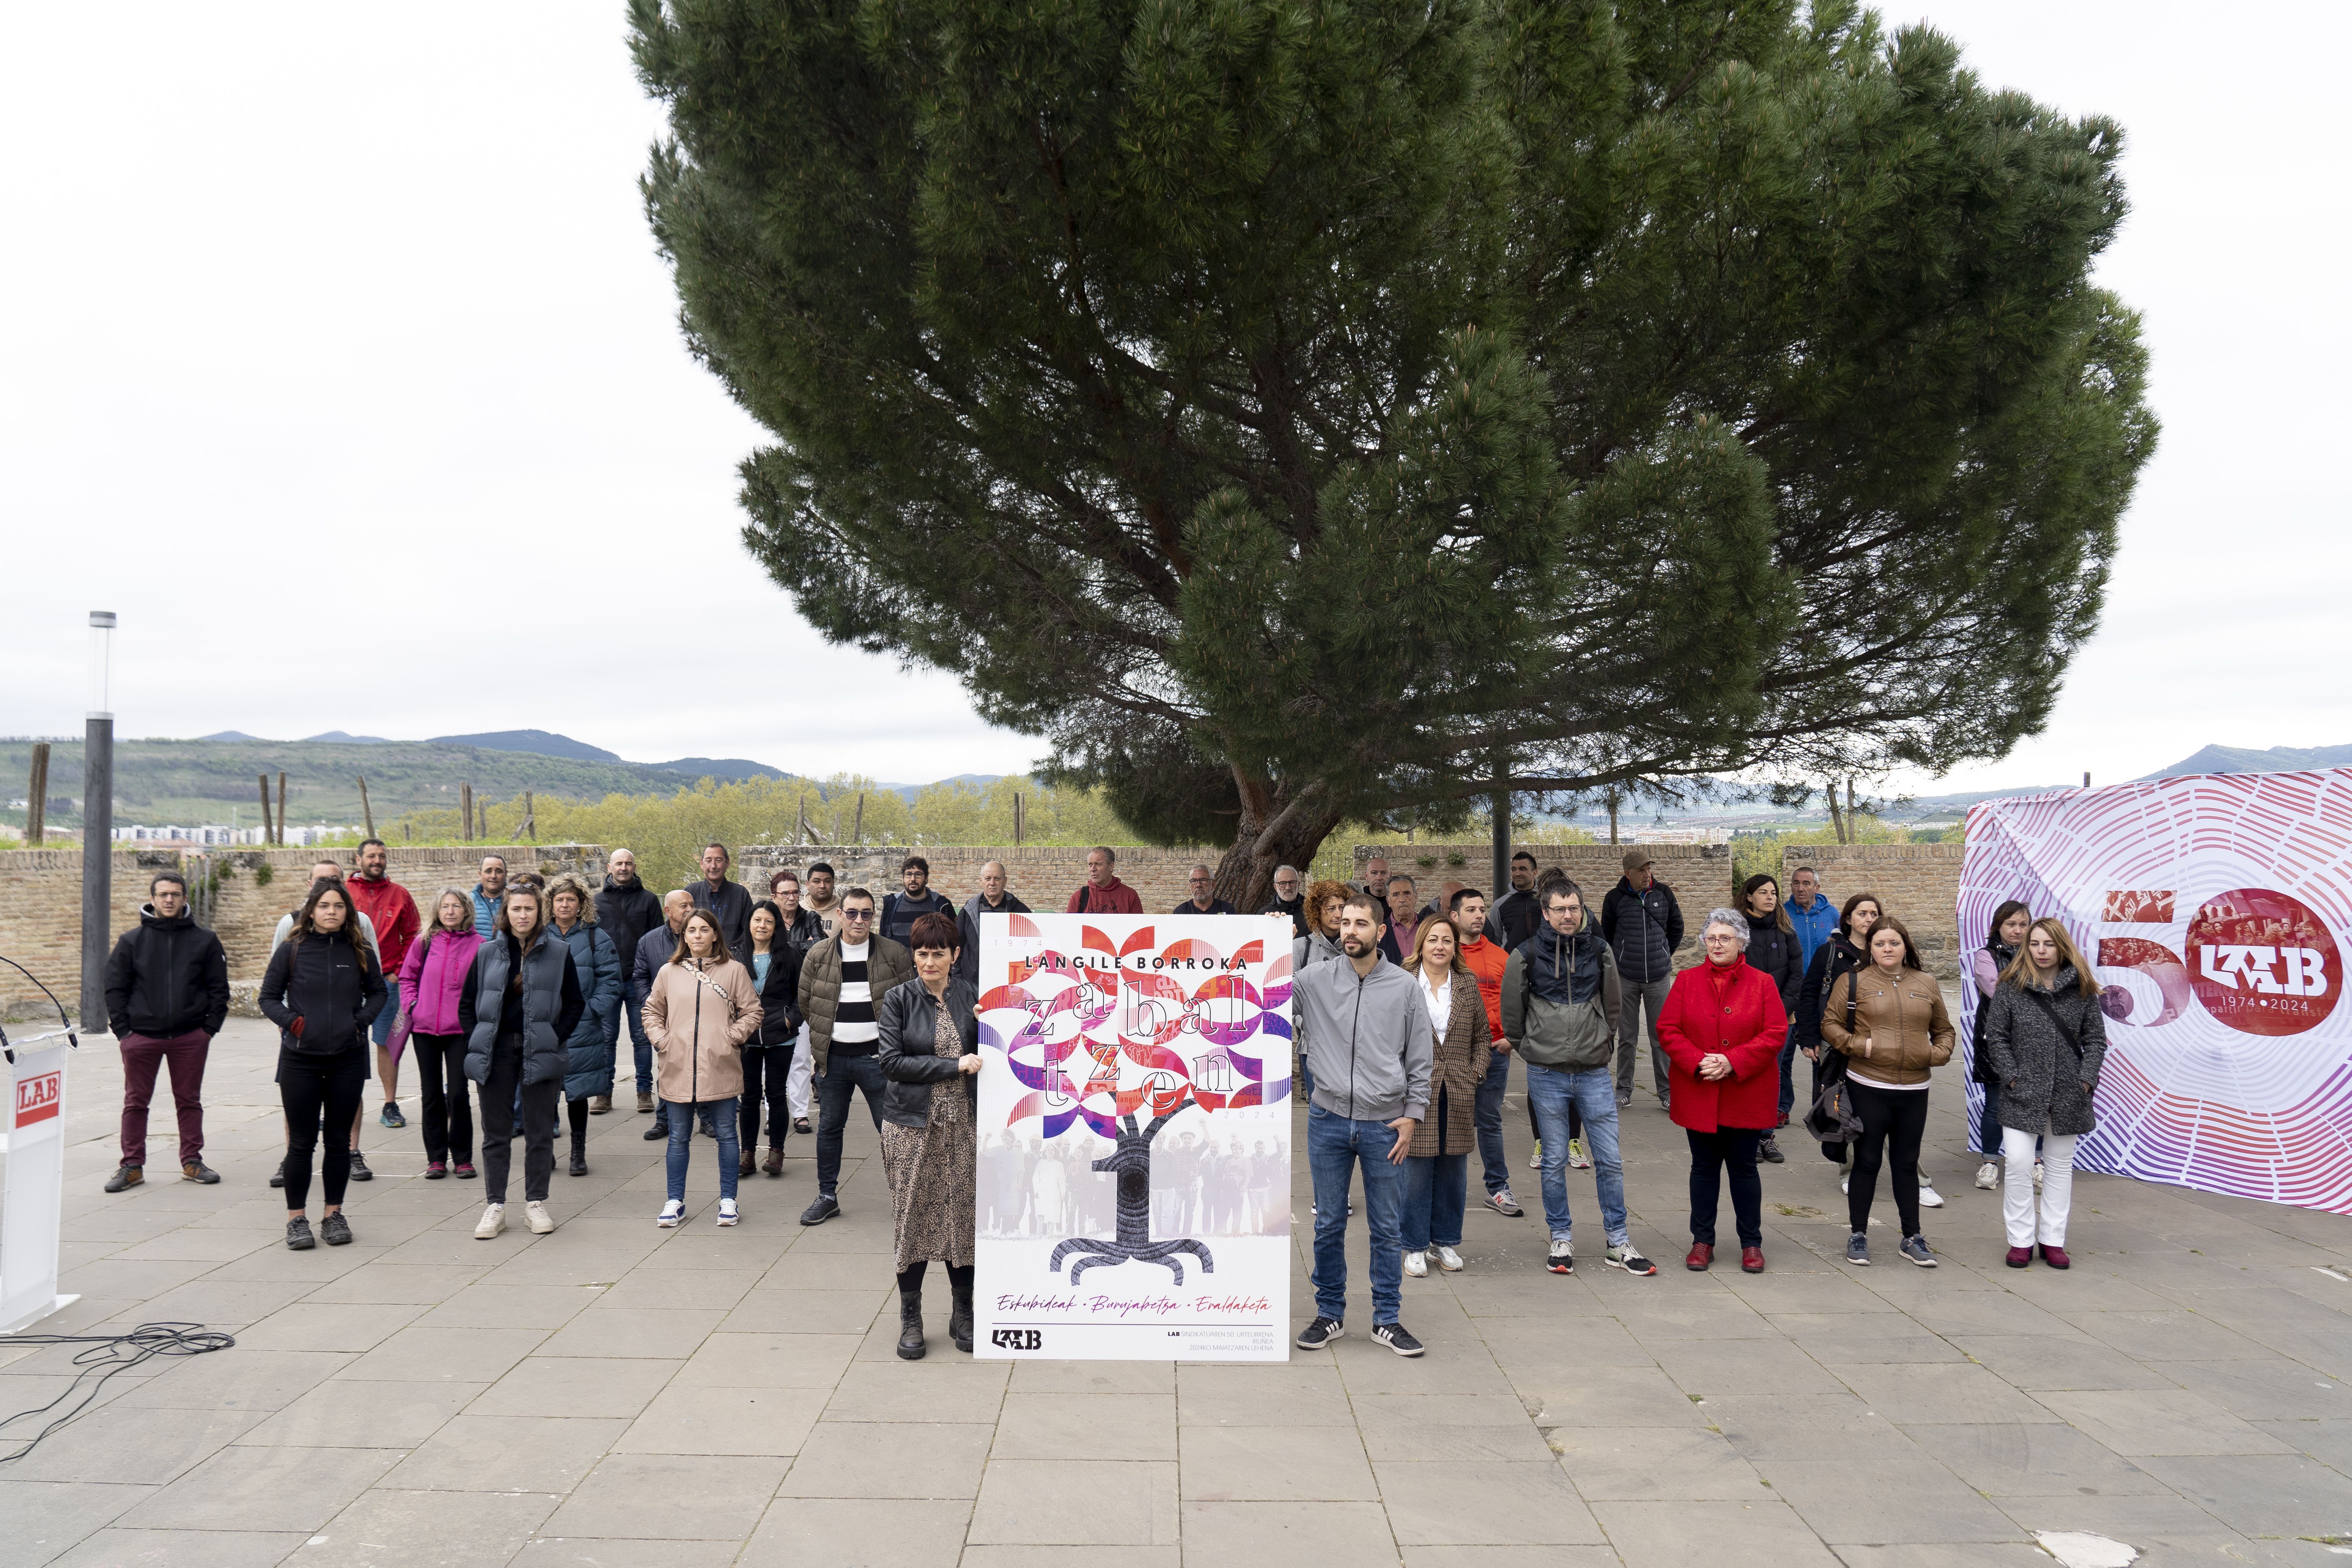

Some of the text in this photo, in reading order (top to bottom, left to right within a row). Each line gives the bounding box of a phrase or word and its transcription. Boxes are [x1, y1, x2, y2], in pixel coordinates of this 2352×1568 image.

[1025, 956, 1122, 969] LANGILE
[1138, 956, 1247, 970] BORROKA
[2200, 944, 2328, 996] LAB
[20, 1077, 58, 1110] LAB
[997, 1294, 1272, 1318] Eskubideak Burujabetza Eraldaketa
[992, 1329, 1042, 1350] LAB
